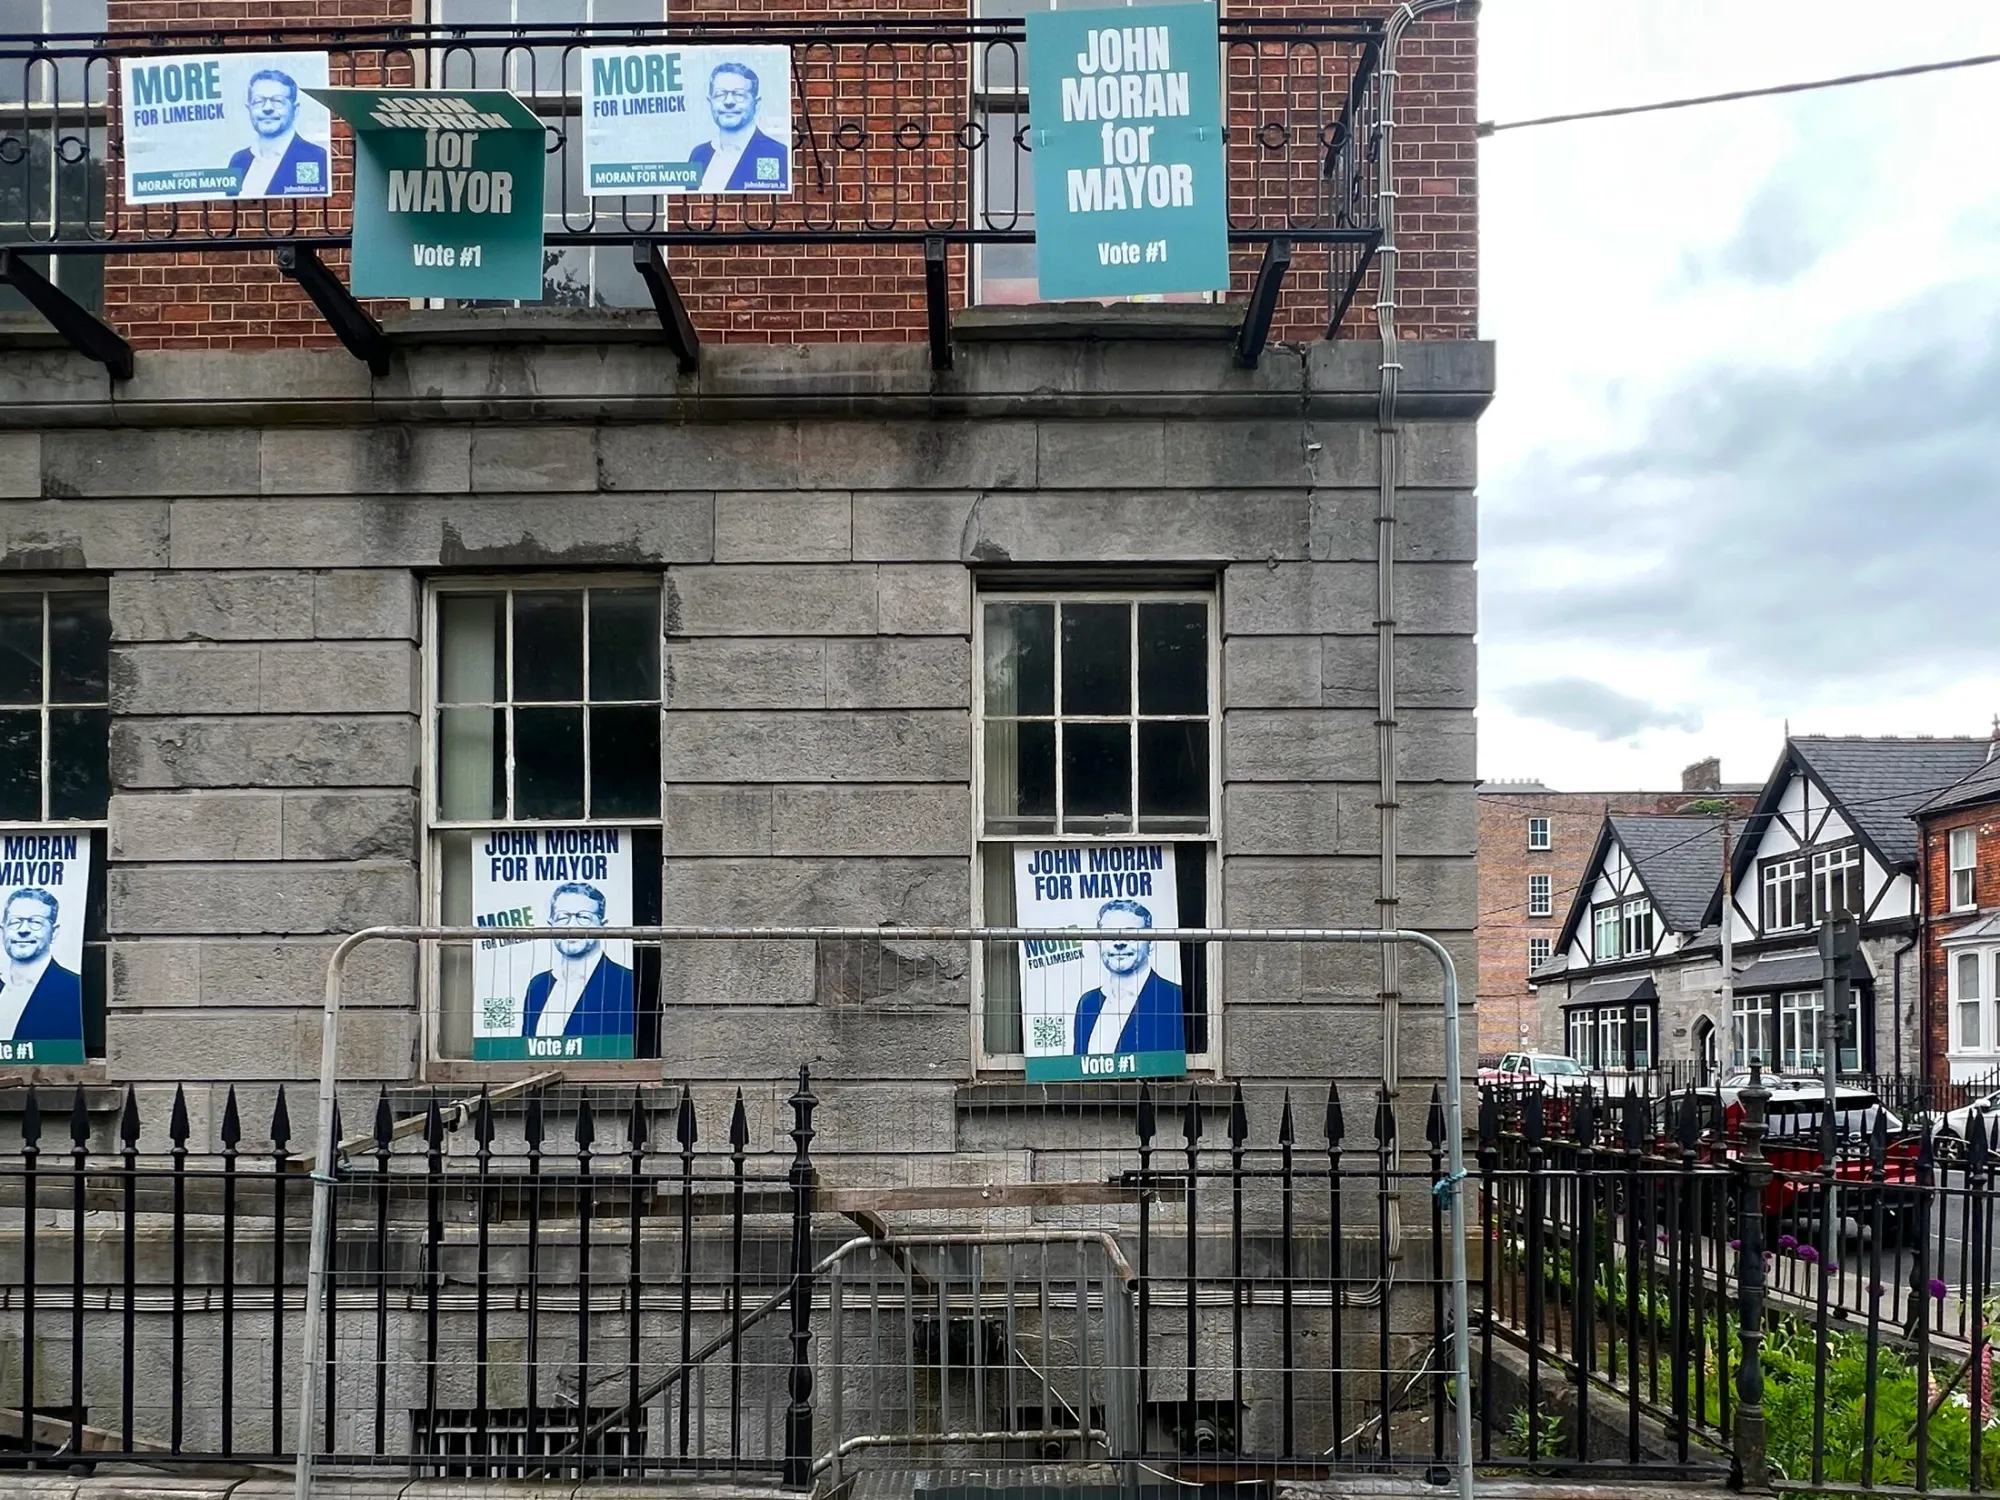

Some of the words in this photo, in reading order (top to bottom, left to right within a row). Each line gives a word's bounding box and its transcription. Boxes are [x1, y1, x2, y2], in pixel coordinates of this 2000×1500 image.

[1077, 26, 1170, 74] JOHN
[132, 61, 222, 105] MORE
[592, 53, 683, 96] MORE
[376, 97, 478, 113] JOHN
[593, 100, 618, 118] FOR
[623, 95, 685, 116] LIMERICK
[1061, 72, 1190, 122] MORAN
[134, 108, 159, 127] FOR
[162, 103, 224, 124] LIMERICK
[369, 112, 513, 129] MORAN
[426, 129, 479, 168] for
[1101, 122, 1154, 165] for
[137, 180, 176, 192] MORAN
[178, 178, 197, 189] FOR
[199, 176, 237, 188] MAYOR
[595, 172, 635, 184] MORAN
[637, 171, 657, 183] FOR
[659, 170, 697, 182] MAYOR
[1067, 164, 1194, 213] MAYOR
[388, 170, 513, 214] MAYOR
[413, 244, 455, 267] Vote
[459, 245, 481, 267] #1
[1098, 242, 1141, 266] Vote
[1145, 240, 1168, 263] #1
[4, 836, 77, 860] MORAN
[485, 831, 537, 856] JOHN
[545, 829, 619, 855] MORAN
[491, 857, 528, 882] FOR
[535, 856, 608, 881] MAYOR
[1028, 849, 1081, 875] JOHN
[1088, 845, 1163, 872] MORAN
[1035, 875, 1072, 900] FOR
[1080, 872, 1152, 898] MAYOR
[1028, 957, 1045, 969] FOR
[1046, 949, 1084, 966] LIMERICK
[16, 1042, 34, 1060] #1
[528, 1038, 561, 1056] Vote
[565, 1037, 583, 1056] #1
[1080, 1056, 1114, 1075] Vote
[1118, 1056, 1136, 1073] #1
